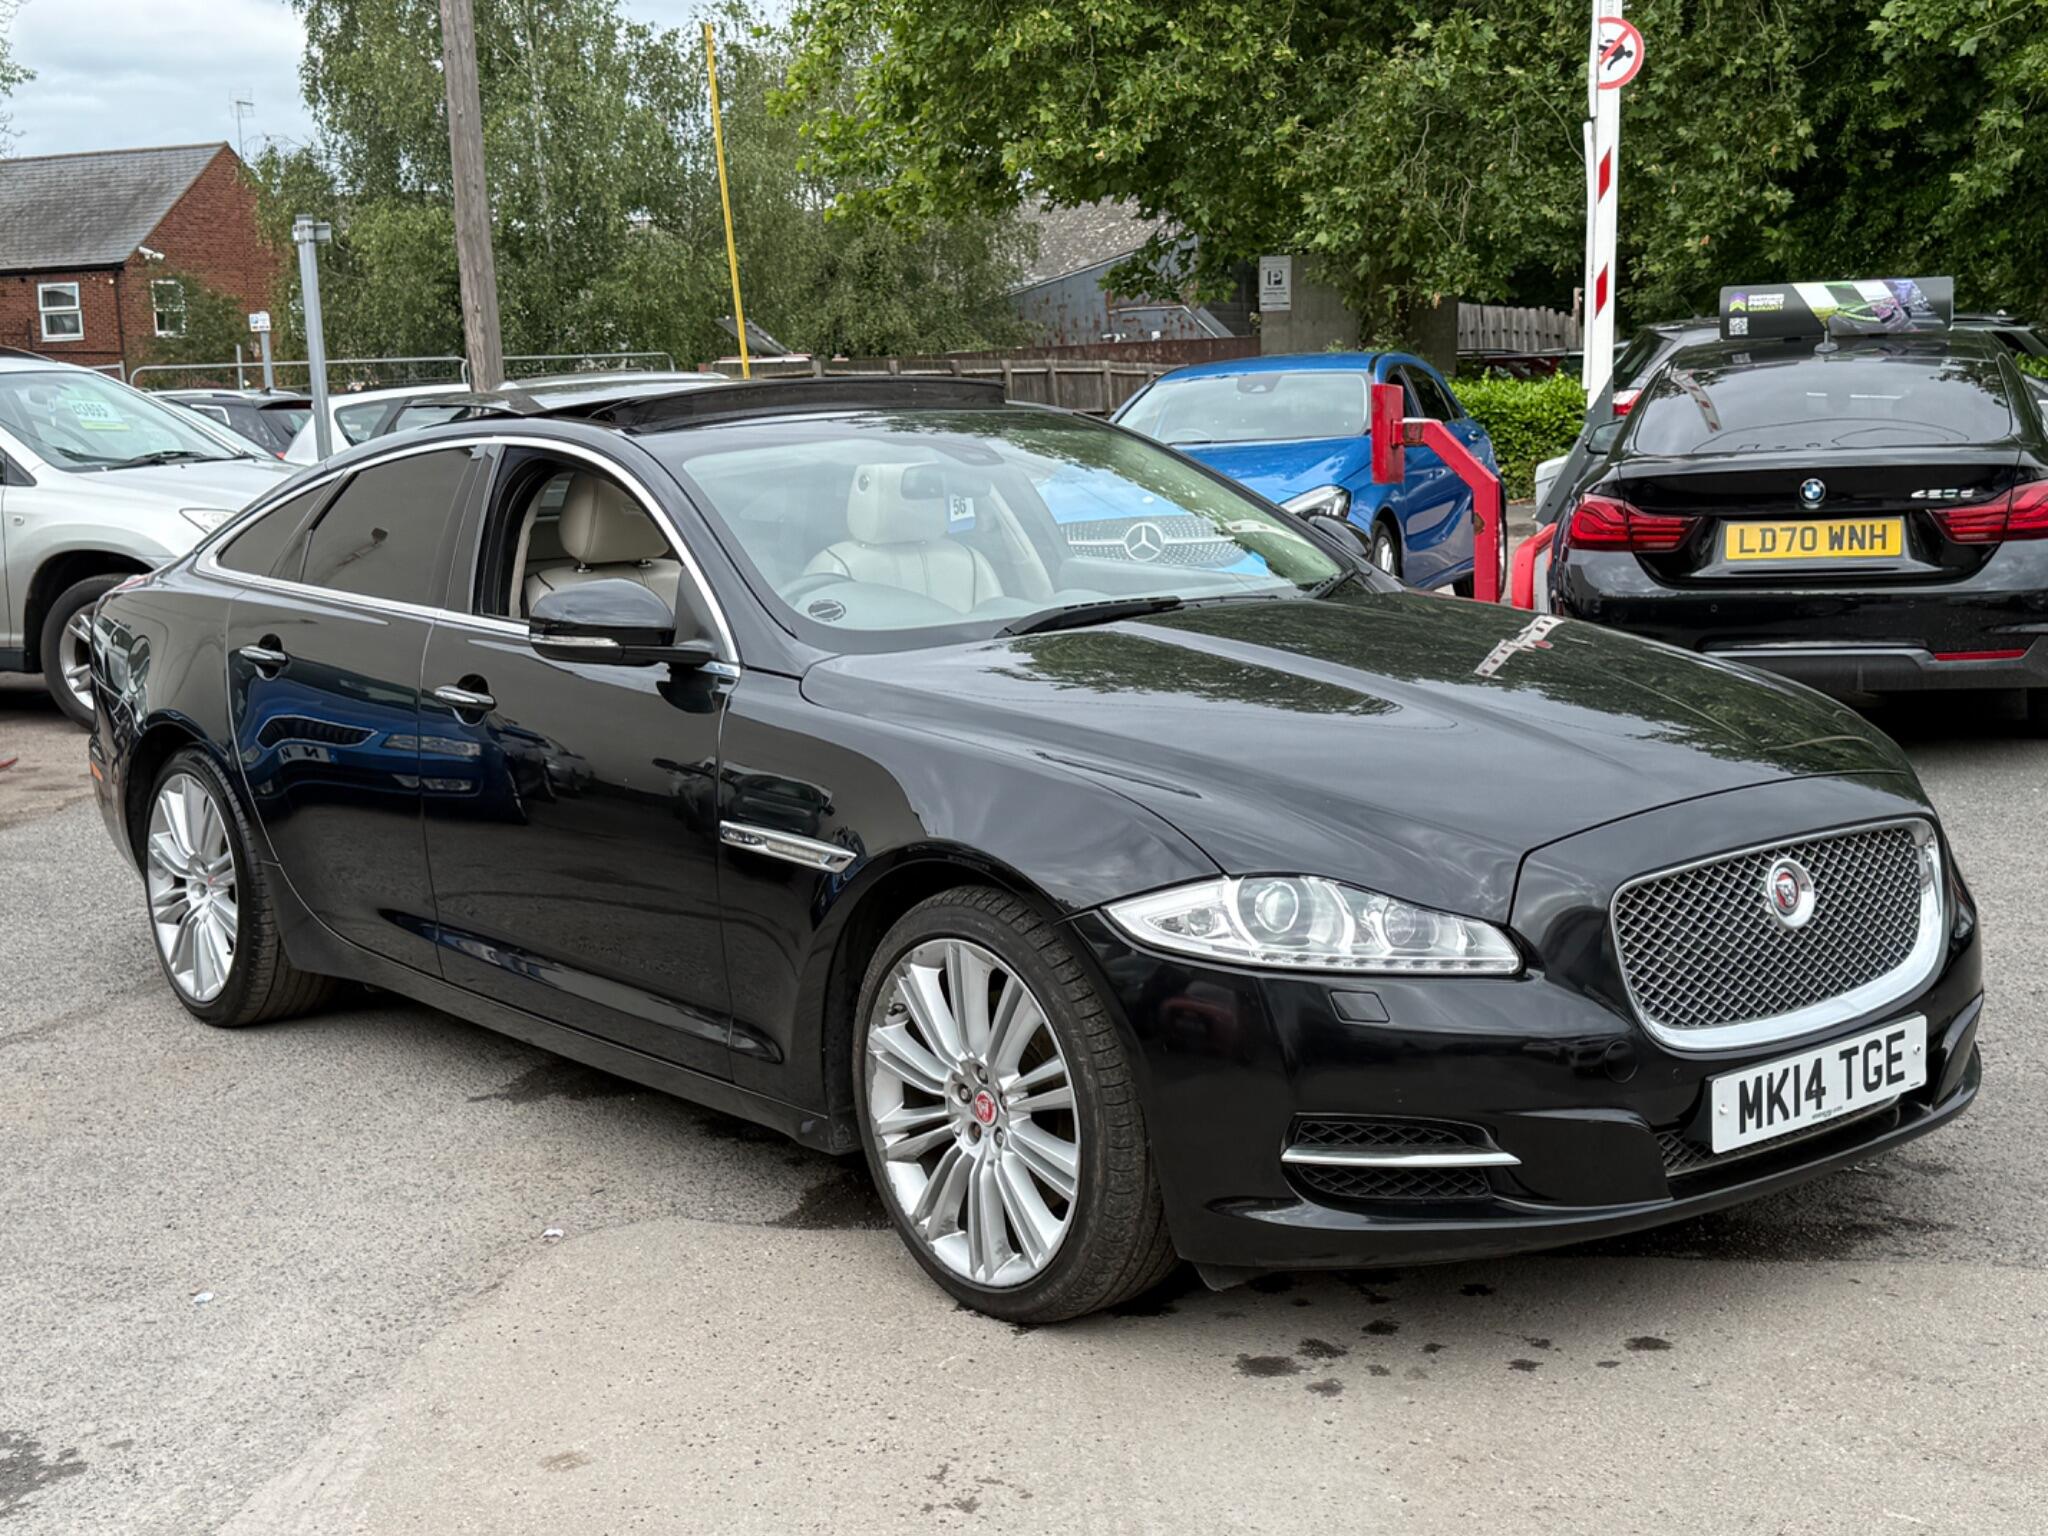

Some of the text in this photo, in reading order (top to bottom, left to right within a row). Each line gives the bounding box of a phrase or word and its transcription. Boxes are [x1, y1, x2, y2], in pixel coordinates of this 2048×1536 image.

[1739, 523, 1887, 554] LD70 WNH
[1739, 1029, 1906, 1135] MK14 TGE
